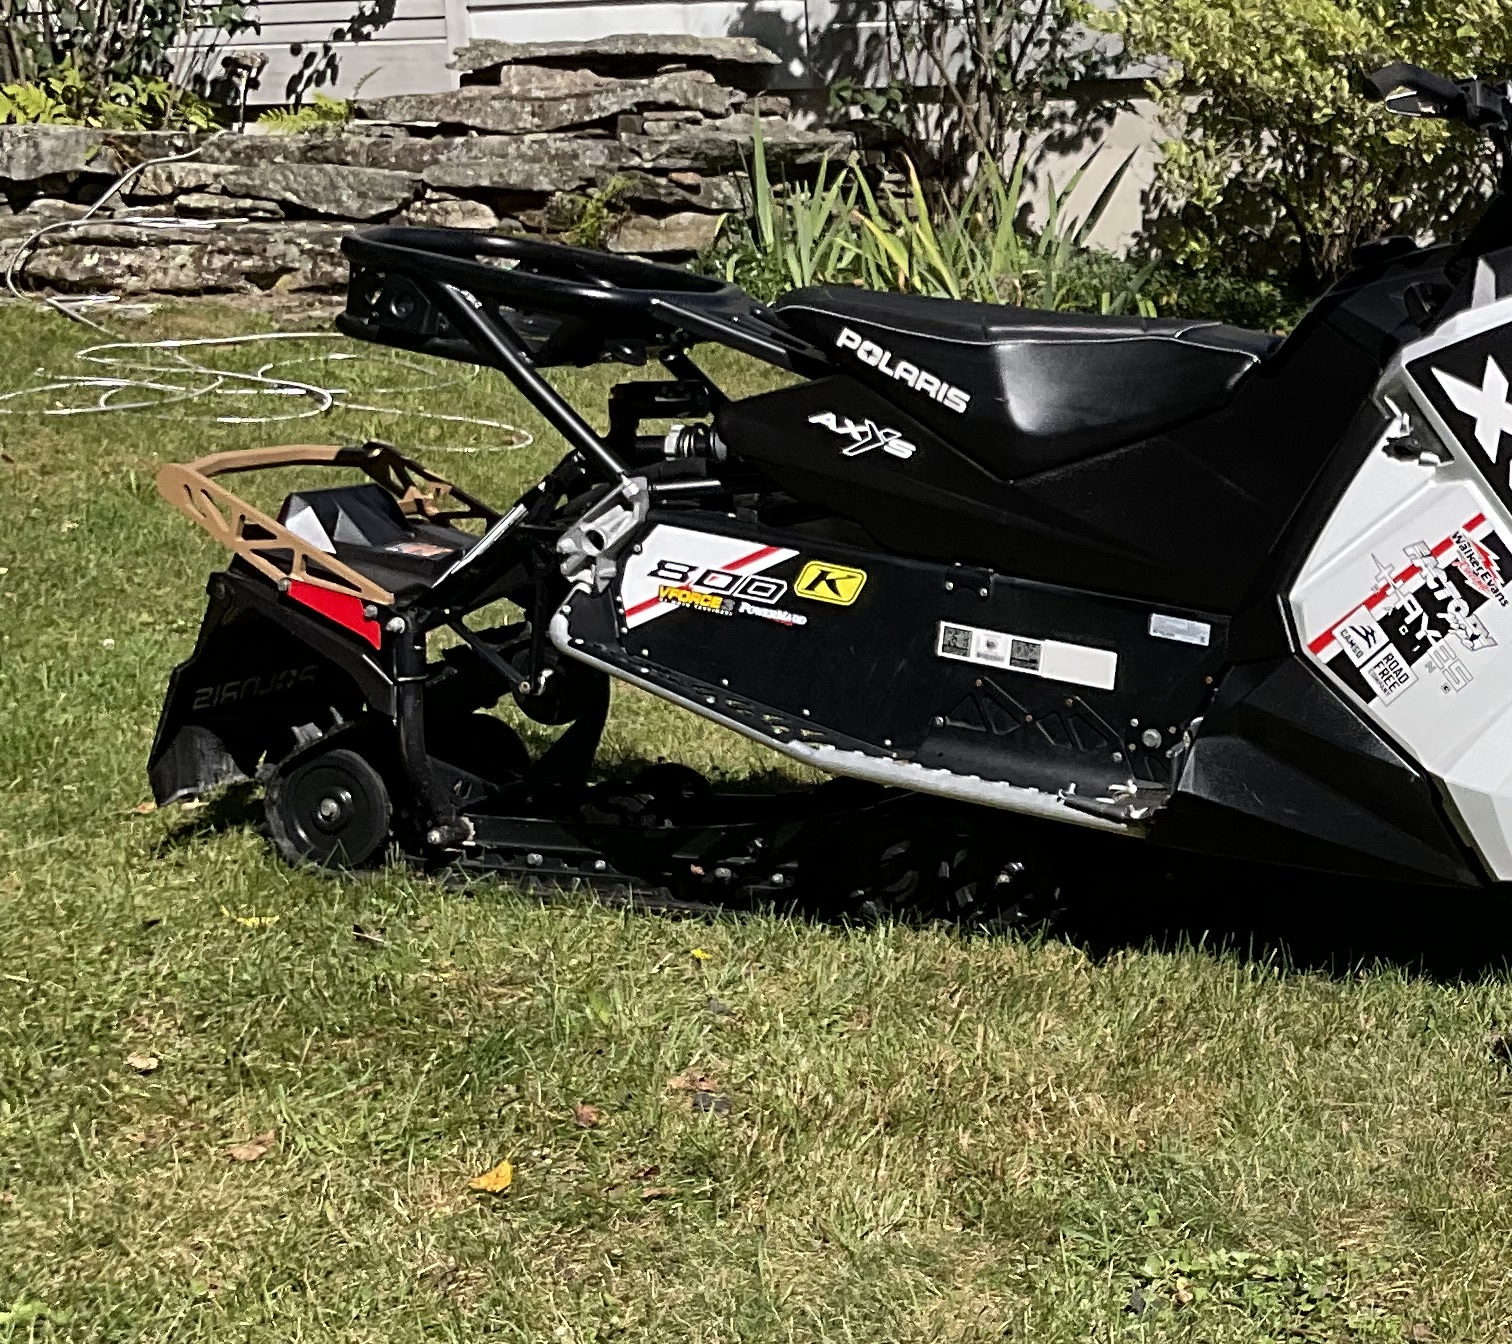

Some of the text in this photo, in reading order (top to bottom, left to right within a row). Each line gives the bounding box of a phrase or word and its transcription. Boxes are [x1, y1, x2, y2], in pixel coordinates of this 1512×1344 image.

[836, 326, 971, 413] POLARIS
[807, 411, 917, 459] AXYS
[647, 559, 788, 605] 800
[1403, 540, 1498, 651] FACTORY
[1451, 530, 1486, 576] Walker
[1480, 572, 1510, 607] Evans
[1371, 553, 1474, 692] HAYES
[1373, 660, 1401, 692] FREE
[1382, 652, 1410, 685] ROAD
